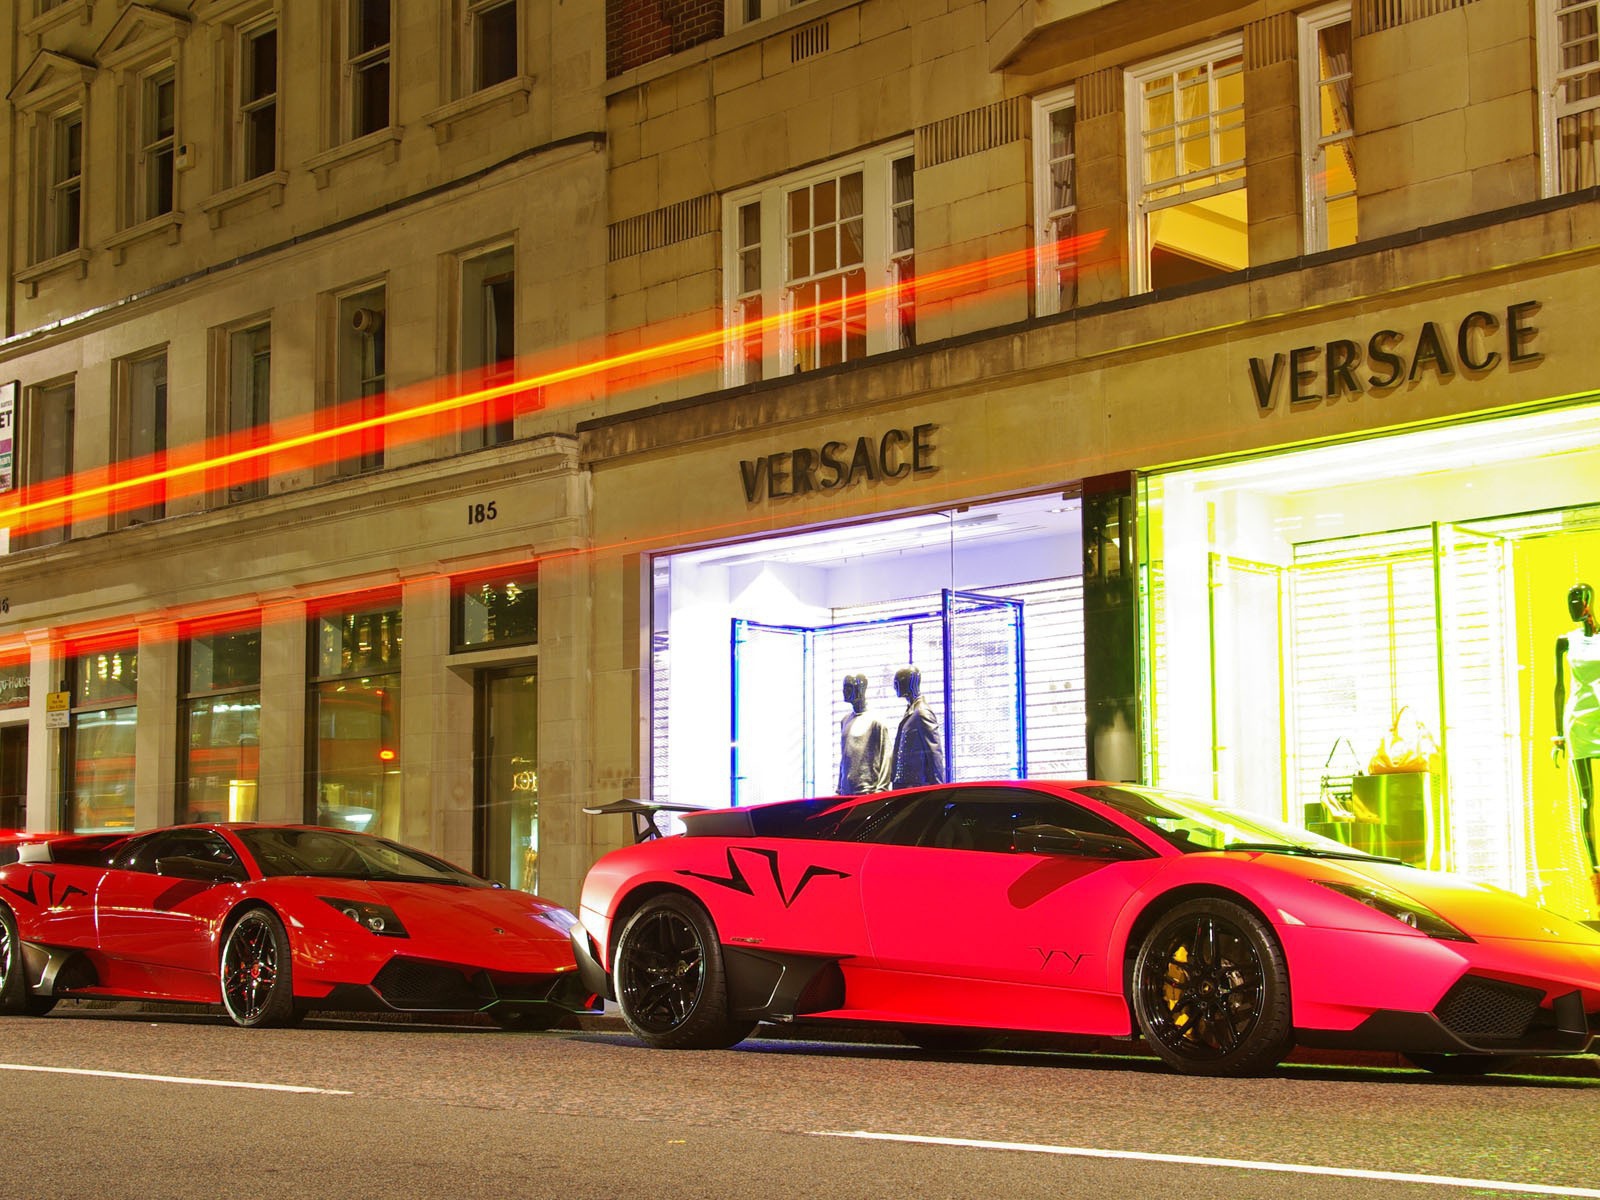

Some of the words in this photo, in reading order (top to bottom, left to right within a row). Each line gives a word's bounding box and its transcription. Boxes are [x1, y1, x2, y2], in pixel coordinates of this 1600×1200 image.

[1248, 300, 1544, 411] VERSACE
[740, 423, 939, 504] VERSACE
[468, 500, 497, 525] 185
